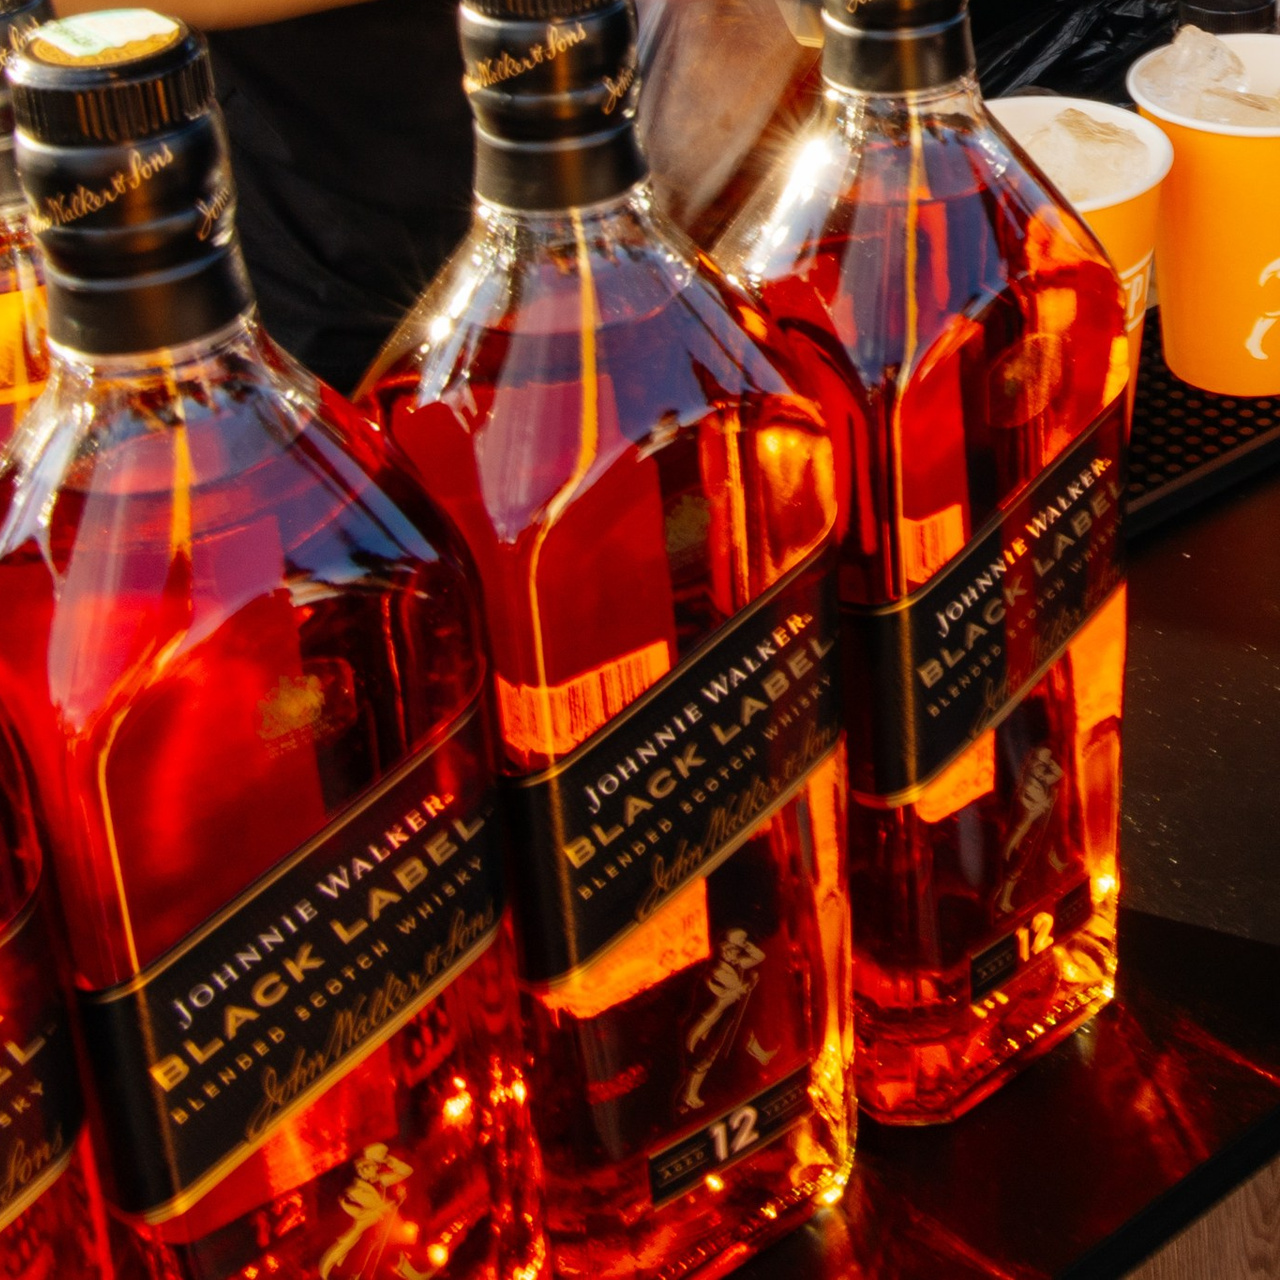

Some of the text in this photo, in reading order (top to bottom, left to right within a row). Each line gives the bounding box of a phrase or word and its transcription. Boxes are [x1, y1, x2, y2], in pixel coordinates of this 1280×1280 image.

[544, 22, 587, 60] Sons
[48, 184, 116, 225] Walker
[125, 144, 174, 190] Sons
[917, 575, 1027, 689] BLACK
[1032, 480, 1124, 577] LABEL
[935, 536, 1027, 638] JOHNNIE
[1025, 457, 1106, 539] WALKER
[564, 742, 706, 869] BLACK
[710, 636, 834, 746] LABEL
[585, 613, 805, 814] JOHNNIE WALKER
[927, 644, 1002, 717] BLENDED
[578, 675, 831, 900] BLENDED SCOTCH WHISKY
[151, 817, 485, 1091] BLACK LABEL
[170, 856, 482, 1125] BLENDED SCOTCH WHISKY
[174, 794, 446, 1030] JOHNNIE WALKER
[1015, 913, 1054, 961] 12
[322, 973, 420, 1063] Walker
[709, 1106, 759, 1162] 12
